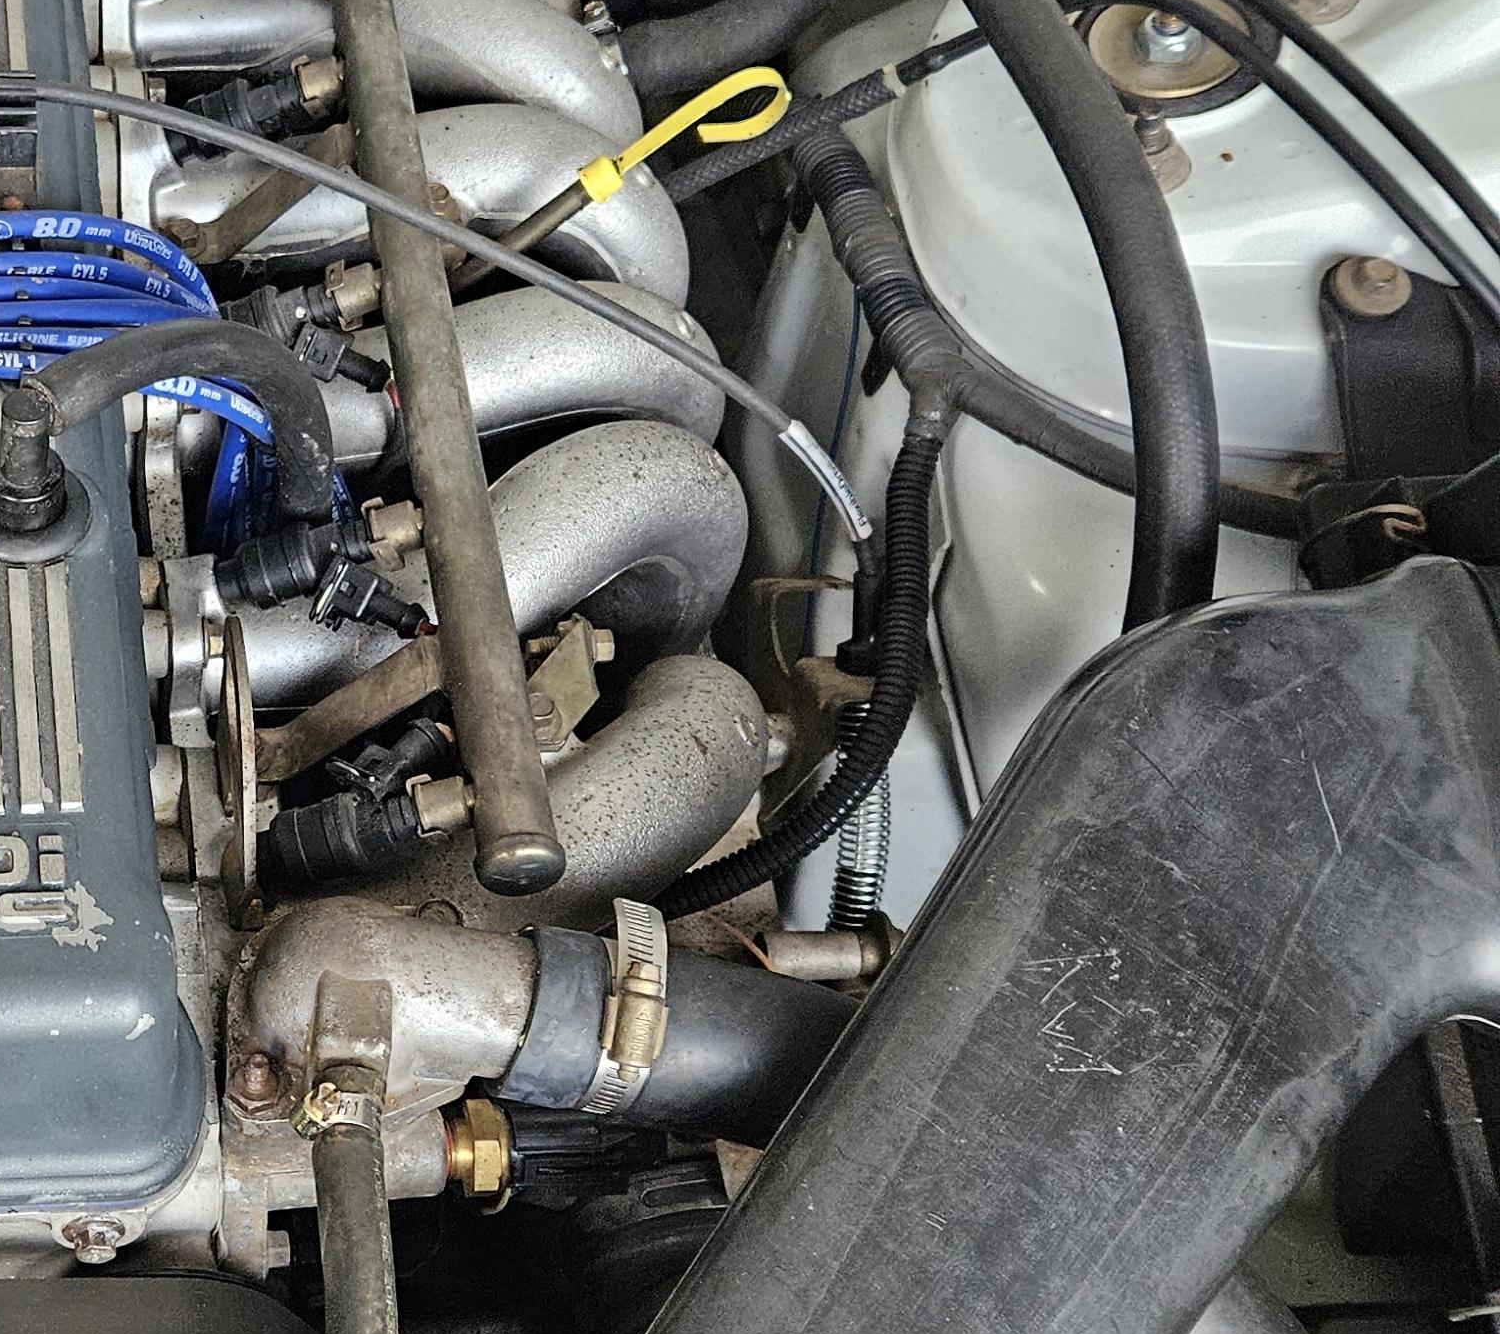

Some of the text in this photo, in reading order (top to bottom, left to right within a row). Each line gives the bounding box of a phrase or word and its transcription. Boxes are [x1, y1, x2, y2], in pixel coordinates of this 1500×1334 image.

[85, 226, 111, 237] mm
[72, 263, 108, 281] CYL 5
[178, 255, 191, 276] CYL
[145, 277, 170, 298] CYL 5
[28, 355, 36, 369] 1
[200, 387, 221, 401] mm
